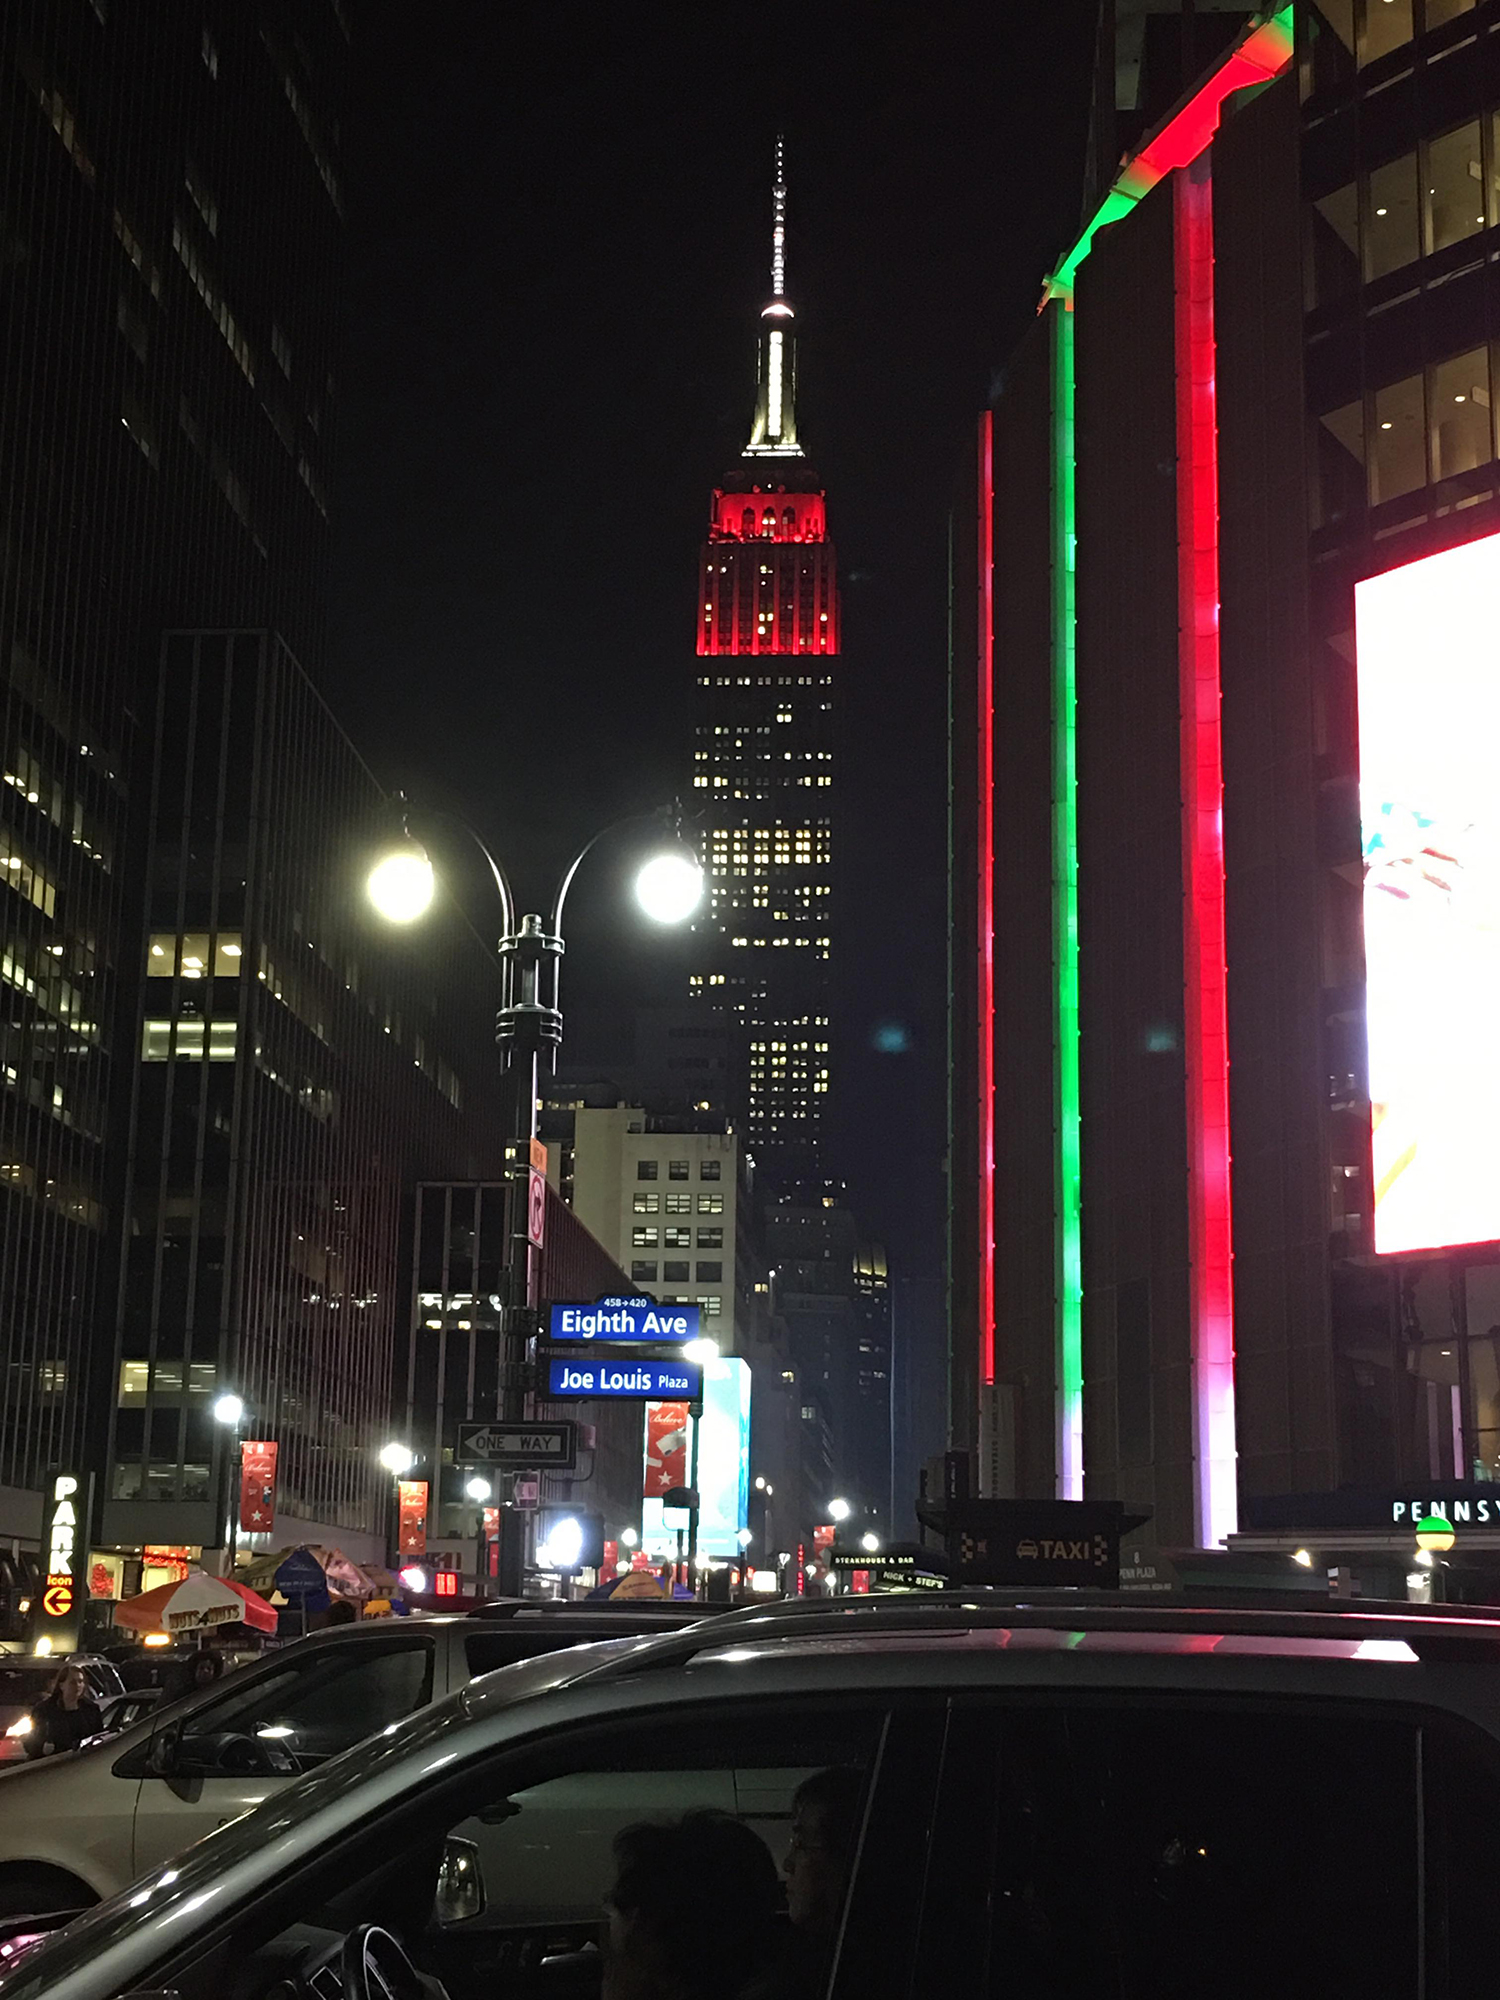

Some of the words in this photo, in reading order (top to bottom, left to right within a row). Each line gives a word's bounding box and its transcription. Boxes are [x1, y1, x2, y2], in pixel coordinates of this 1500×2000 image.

[604, 1298, 620, 1307] 458
[629, 1298, 647, 1308] 420
[561, 1309, 635, 1338] Eighth
[641, 1312, 688, 1334] Ave
[560, 1368, 594, 1389] Joe
[600, 1368, 652, 1390] Louis
[658, 1375, 689, 1388] Plaza
[476, 1436, 505, 1450] ONE
[520, 1436, 553, 1450] WAY
[49, 1476, 78, 1575] PARK
[1040, 1541, 1089, 1559] TAXI
[883, 1571, 904, 1582] NICK
[1136, 1566, 1156, 1578] PLAZA
